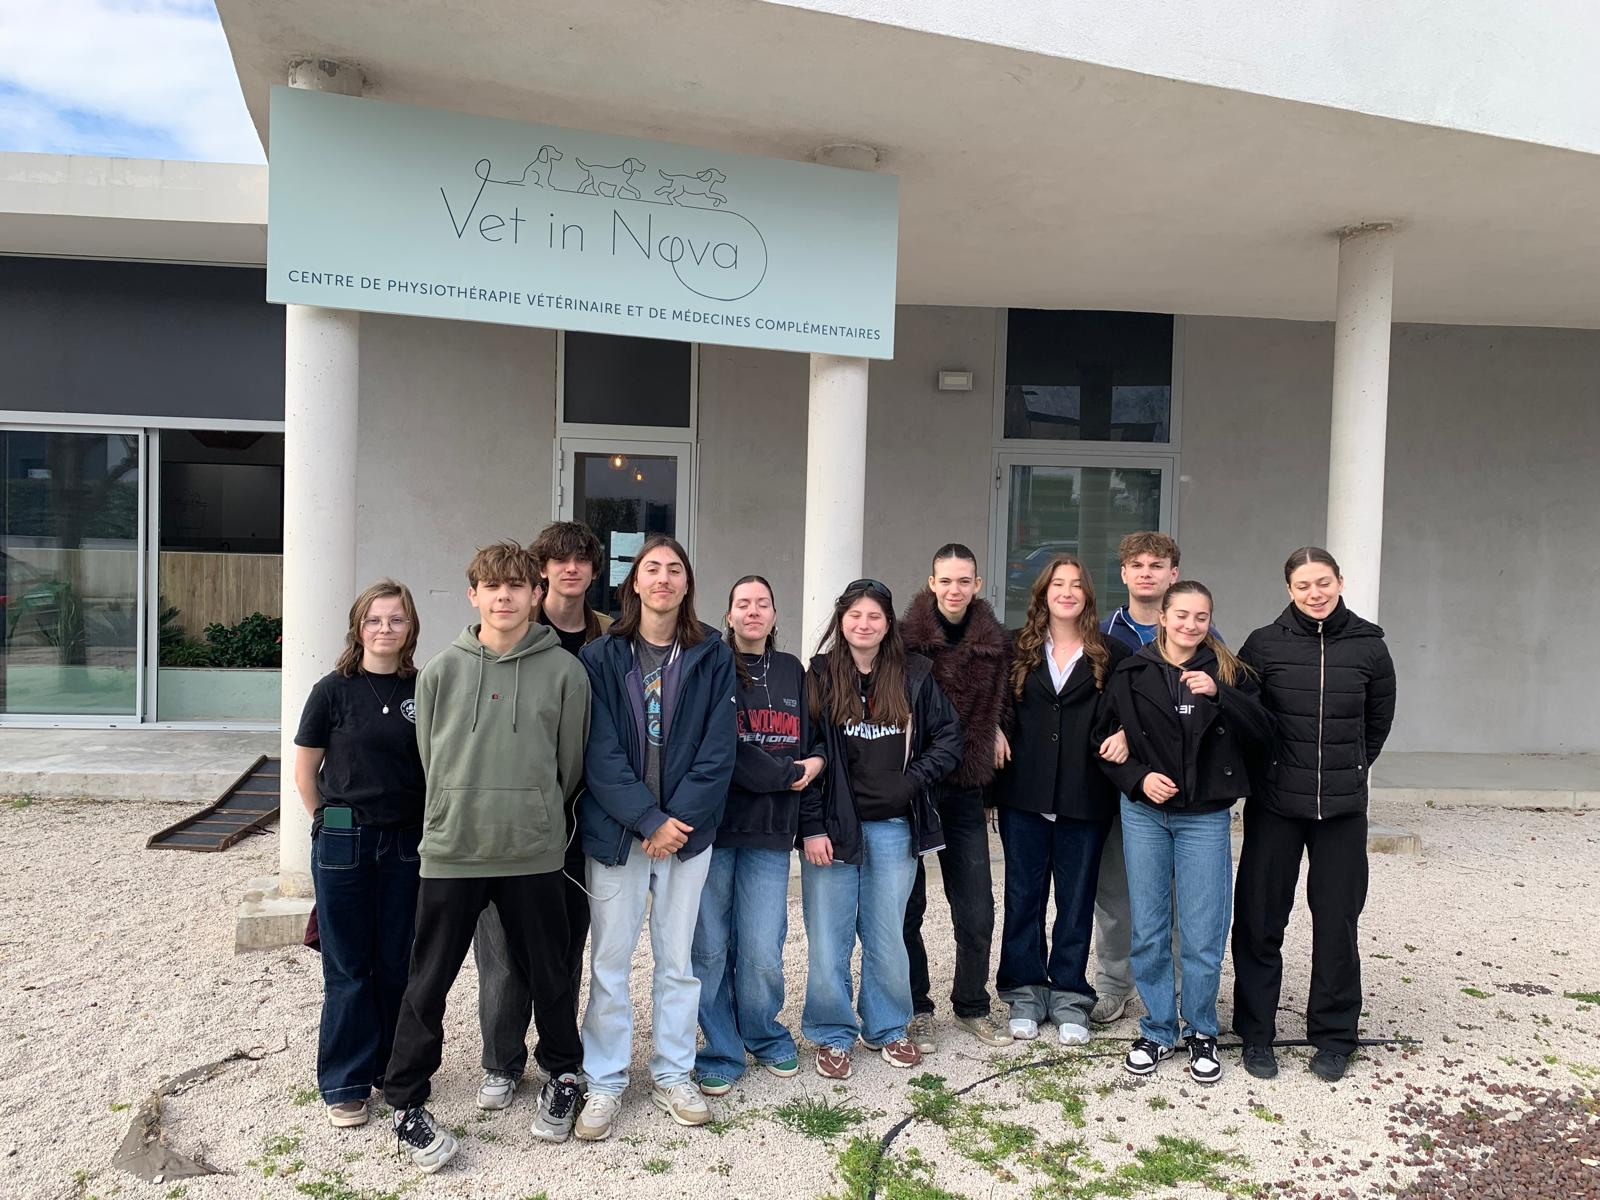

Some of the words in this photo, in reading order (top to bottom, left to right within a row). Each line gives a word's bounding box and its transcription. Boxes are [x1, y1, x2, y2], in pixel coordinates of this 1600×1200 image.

[440, 159, 526, 245] Vet
[549, 212, 584, 253] in
[613, 209, 738, 271] Nova
[288, 269, 355, 288] CENTRE
[360, 276, 382, 291] DE
[387, 279, 522, 304] PHYSIOTHÉRAPIE
[526, 292, 622, 316] VÉTÉRINAIRE
[627, 304, 645, 318] ET
[648, 306, 667, 320] DE
[671, 308, 751, 328] MÉDECINES
[755, 318, 881, 341] COMPLÉMENTAIRES
[844, 718, 905, 740] OPENHAG
